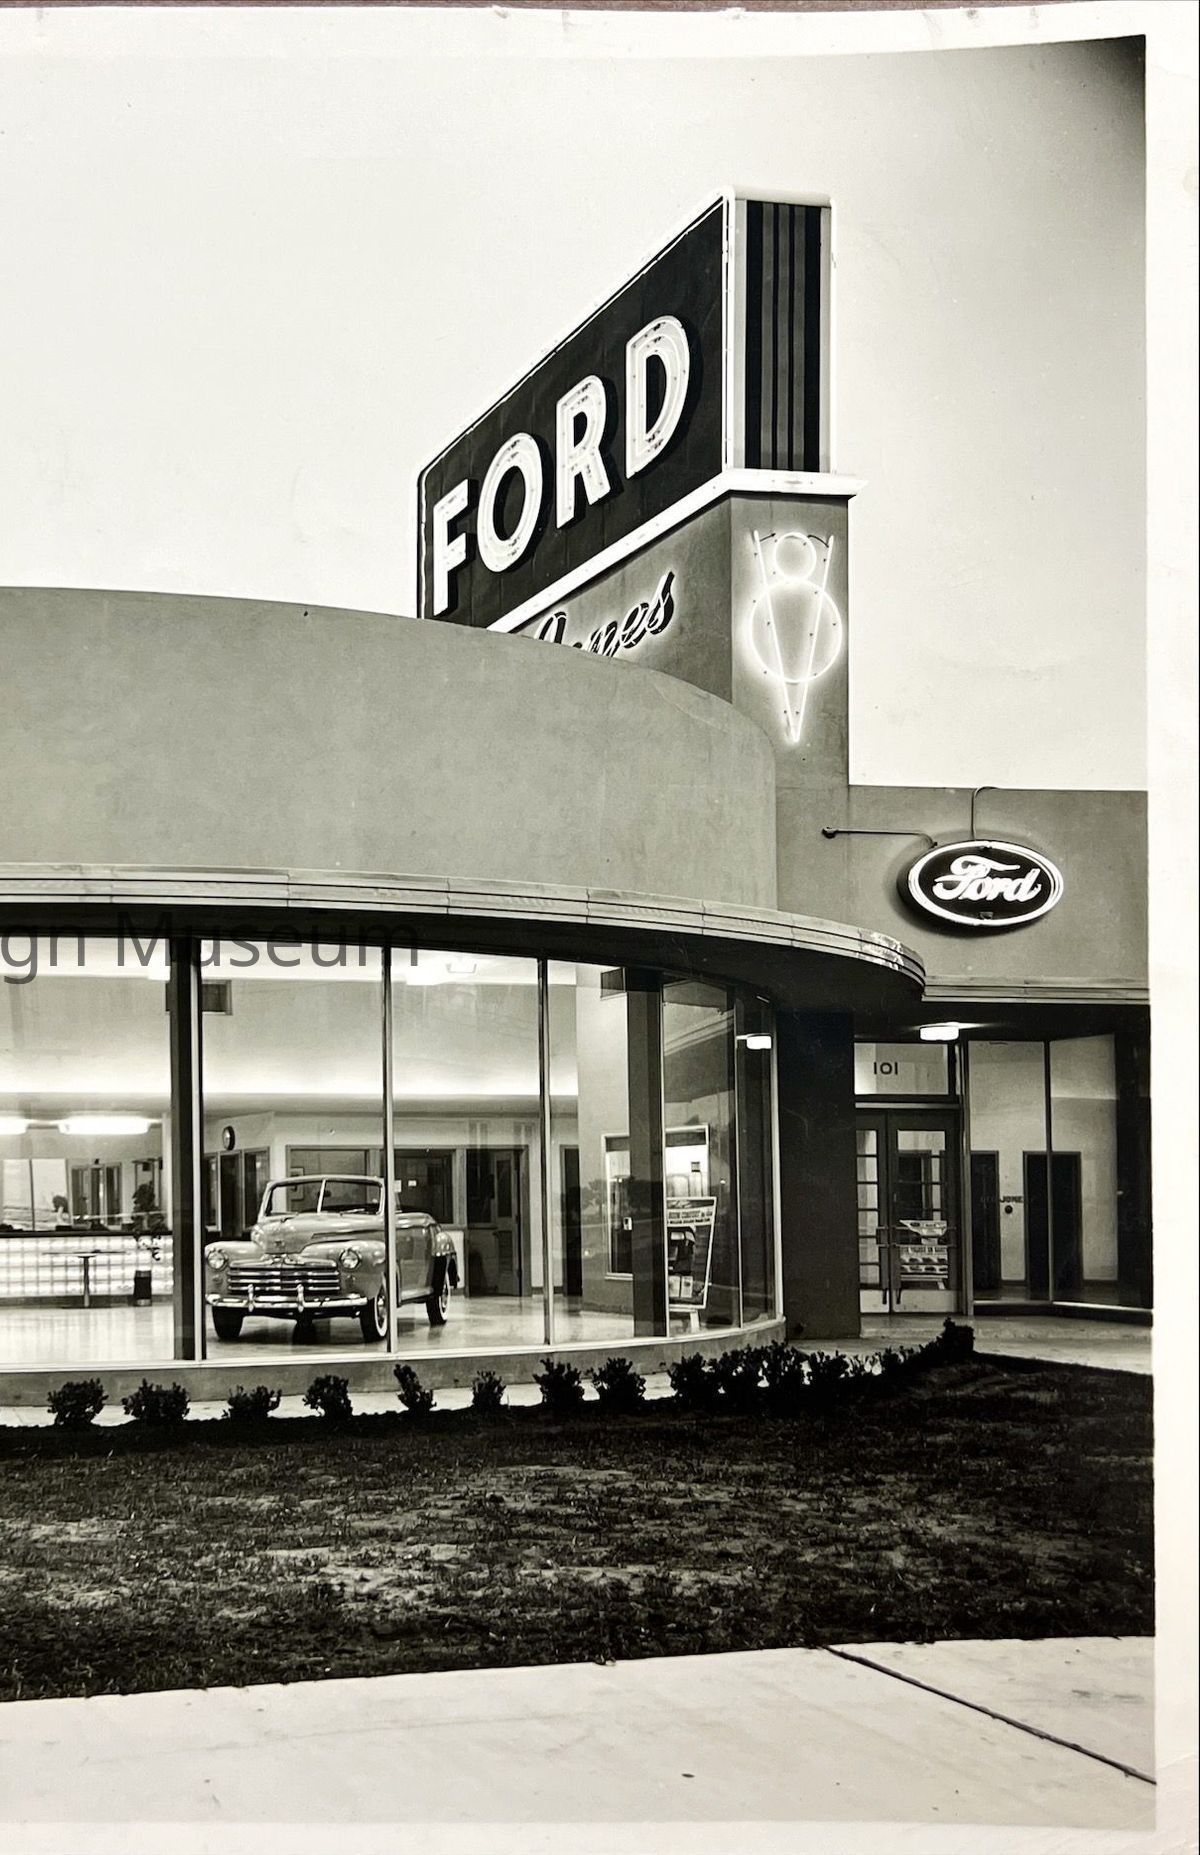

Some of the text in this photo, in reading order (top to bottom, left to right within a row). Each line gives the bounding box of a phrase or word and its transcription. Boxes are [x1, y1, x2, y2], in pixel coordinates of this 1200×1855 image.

[433, 315, 690, 616] FORD
[932, 854, 1043, 902] Ford
[874, 1061, 898, 1075] 101
